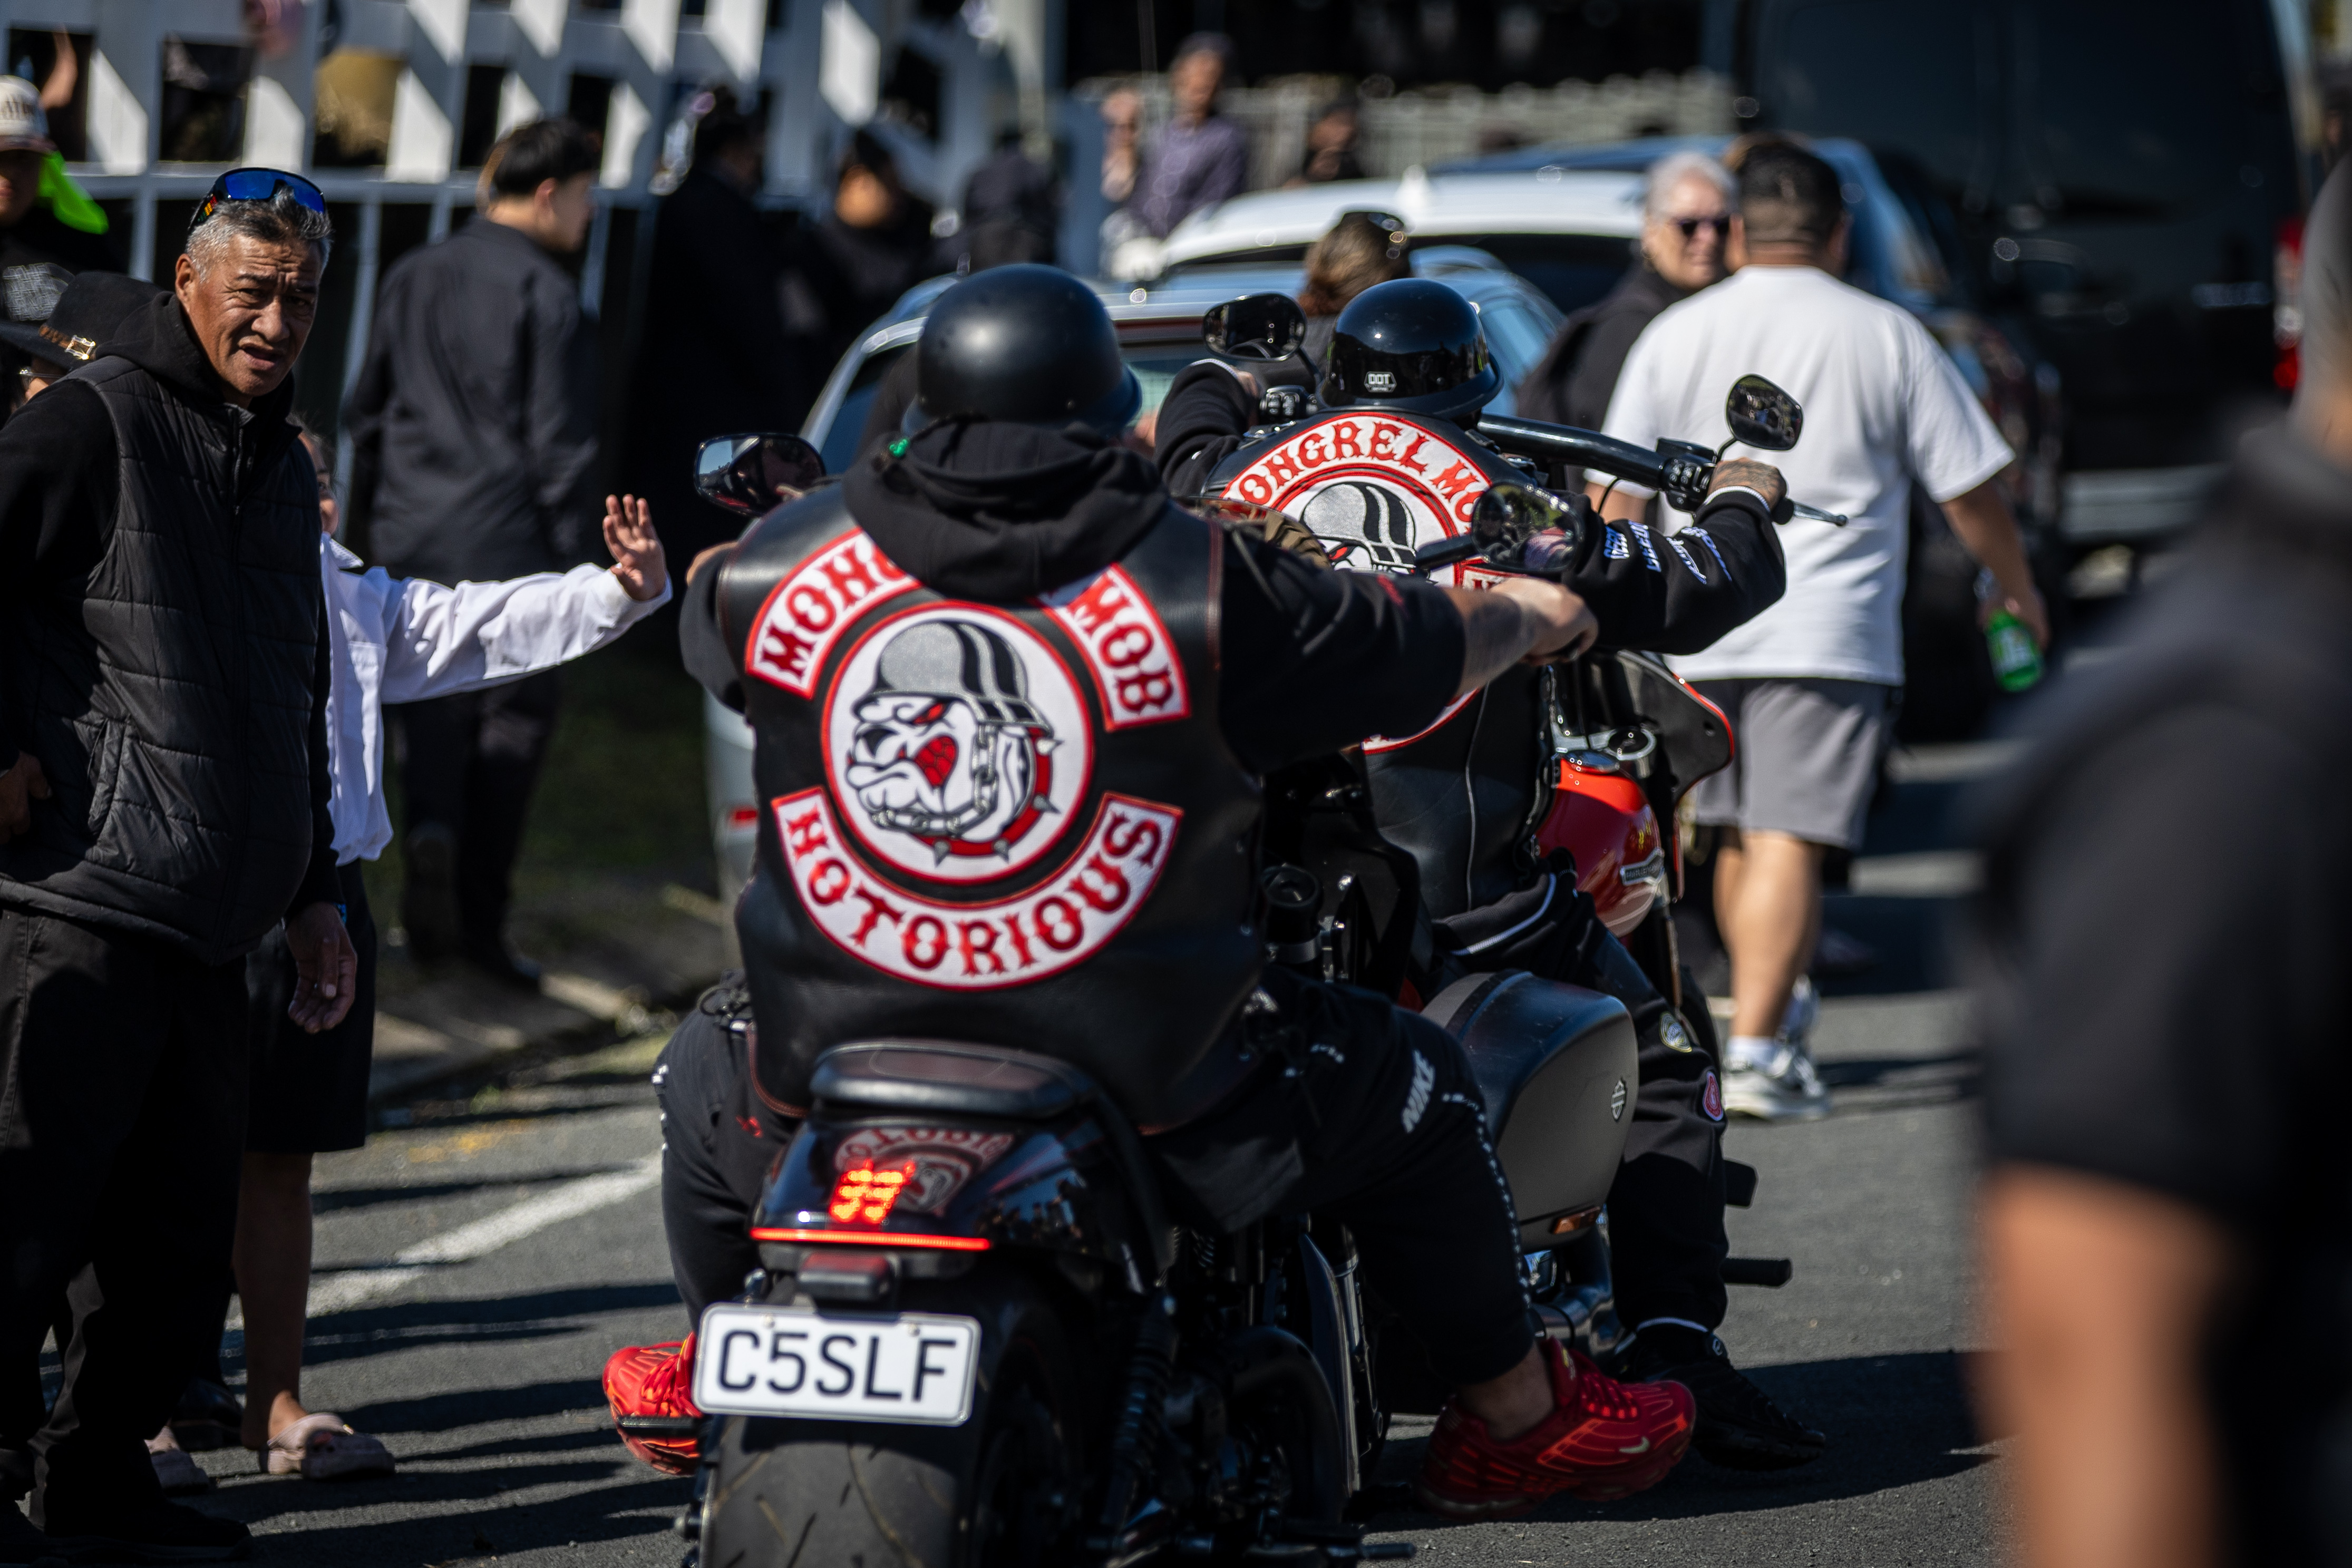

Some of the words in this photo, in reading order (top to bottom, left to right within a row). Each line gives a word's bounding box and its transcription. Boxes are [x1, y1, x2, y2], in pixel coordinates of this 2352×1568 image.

[1368, 373, 1391, 385] DOT
[1237, 420, 1429, 505] ONGREL
[1430, 459, 1485, 526] MO
[1065, 572, 1173, 713] MOB
[788, 804, 1162, 975] NOTORIOUS
[1402, 1049, 1436, 1133] NIKE
[718, 1330, 956, 1403] C5SLF
